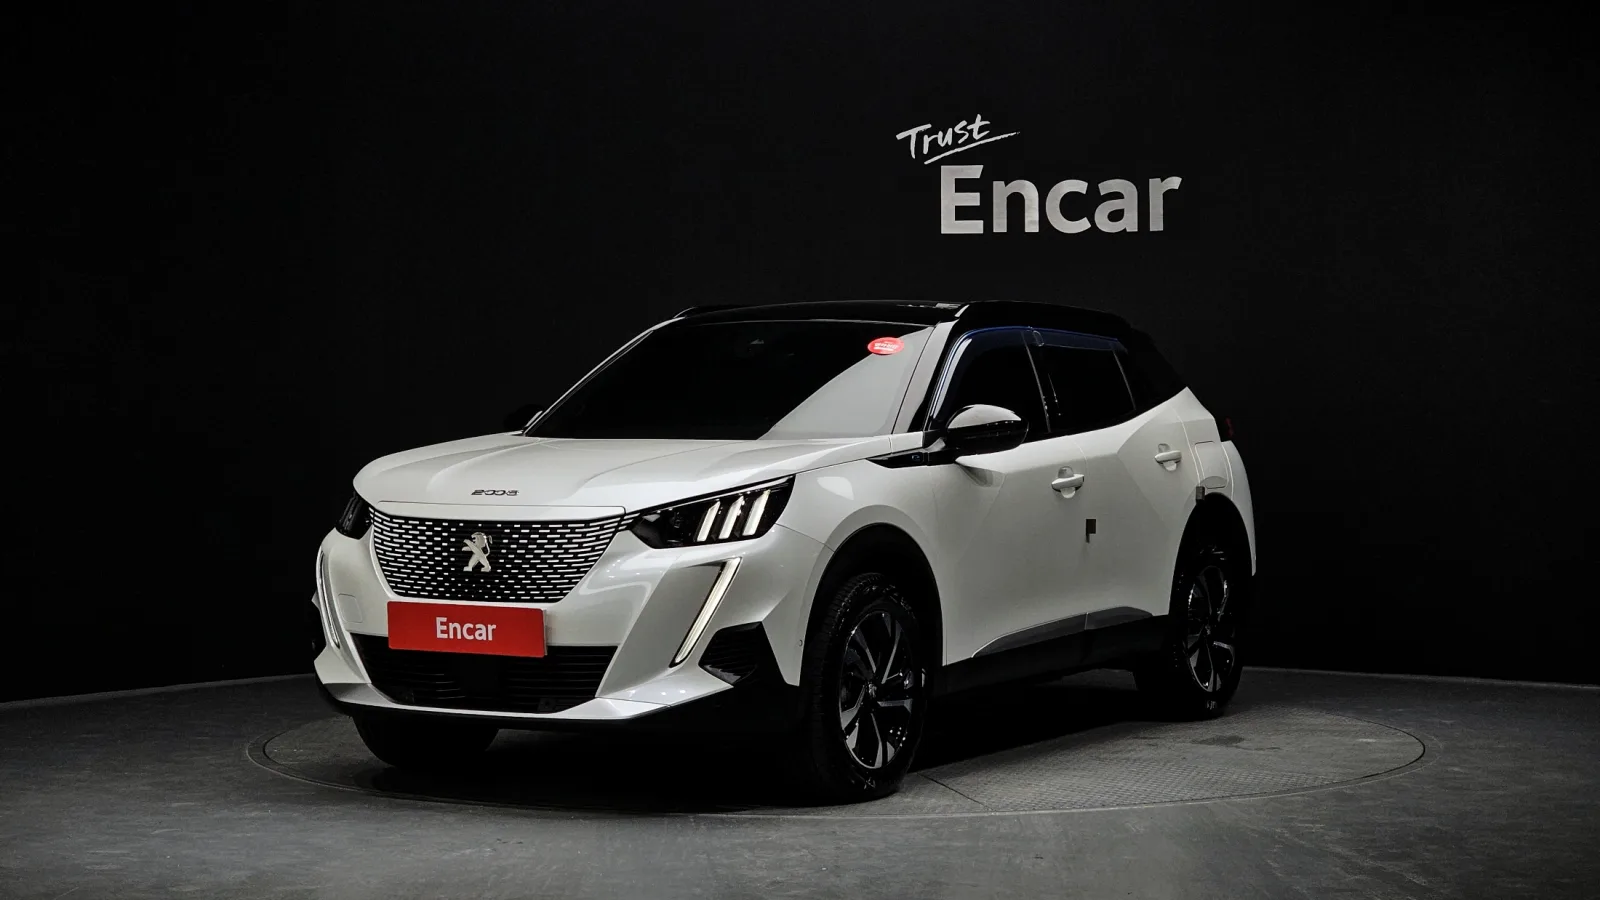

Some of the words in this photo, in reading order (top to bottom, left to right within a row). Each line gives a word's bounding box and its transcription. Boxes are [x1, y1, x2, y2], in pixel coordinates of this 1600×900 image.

[896, 114, 990, 159] Trust
[940, 164, 1183, 234] Encar
[436, 616, 497, 641] Encar
